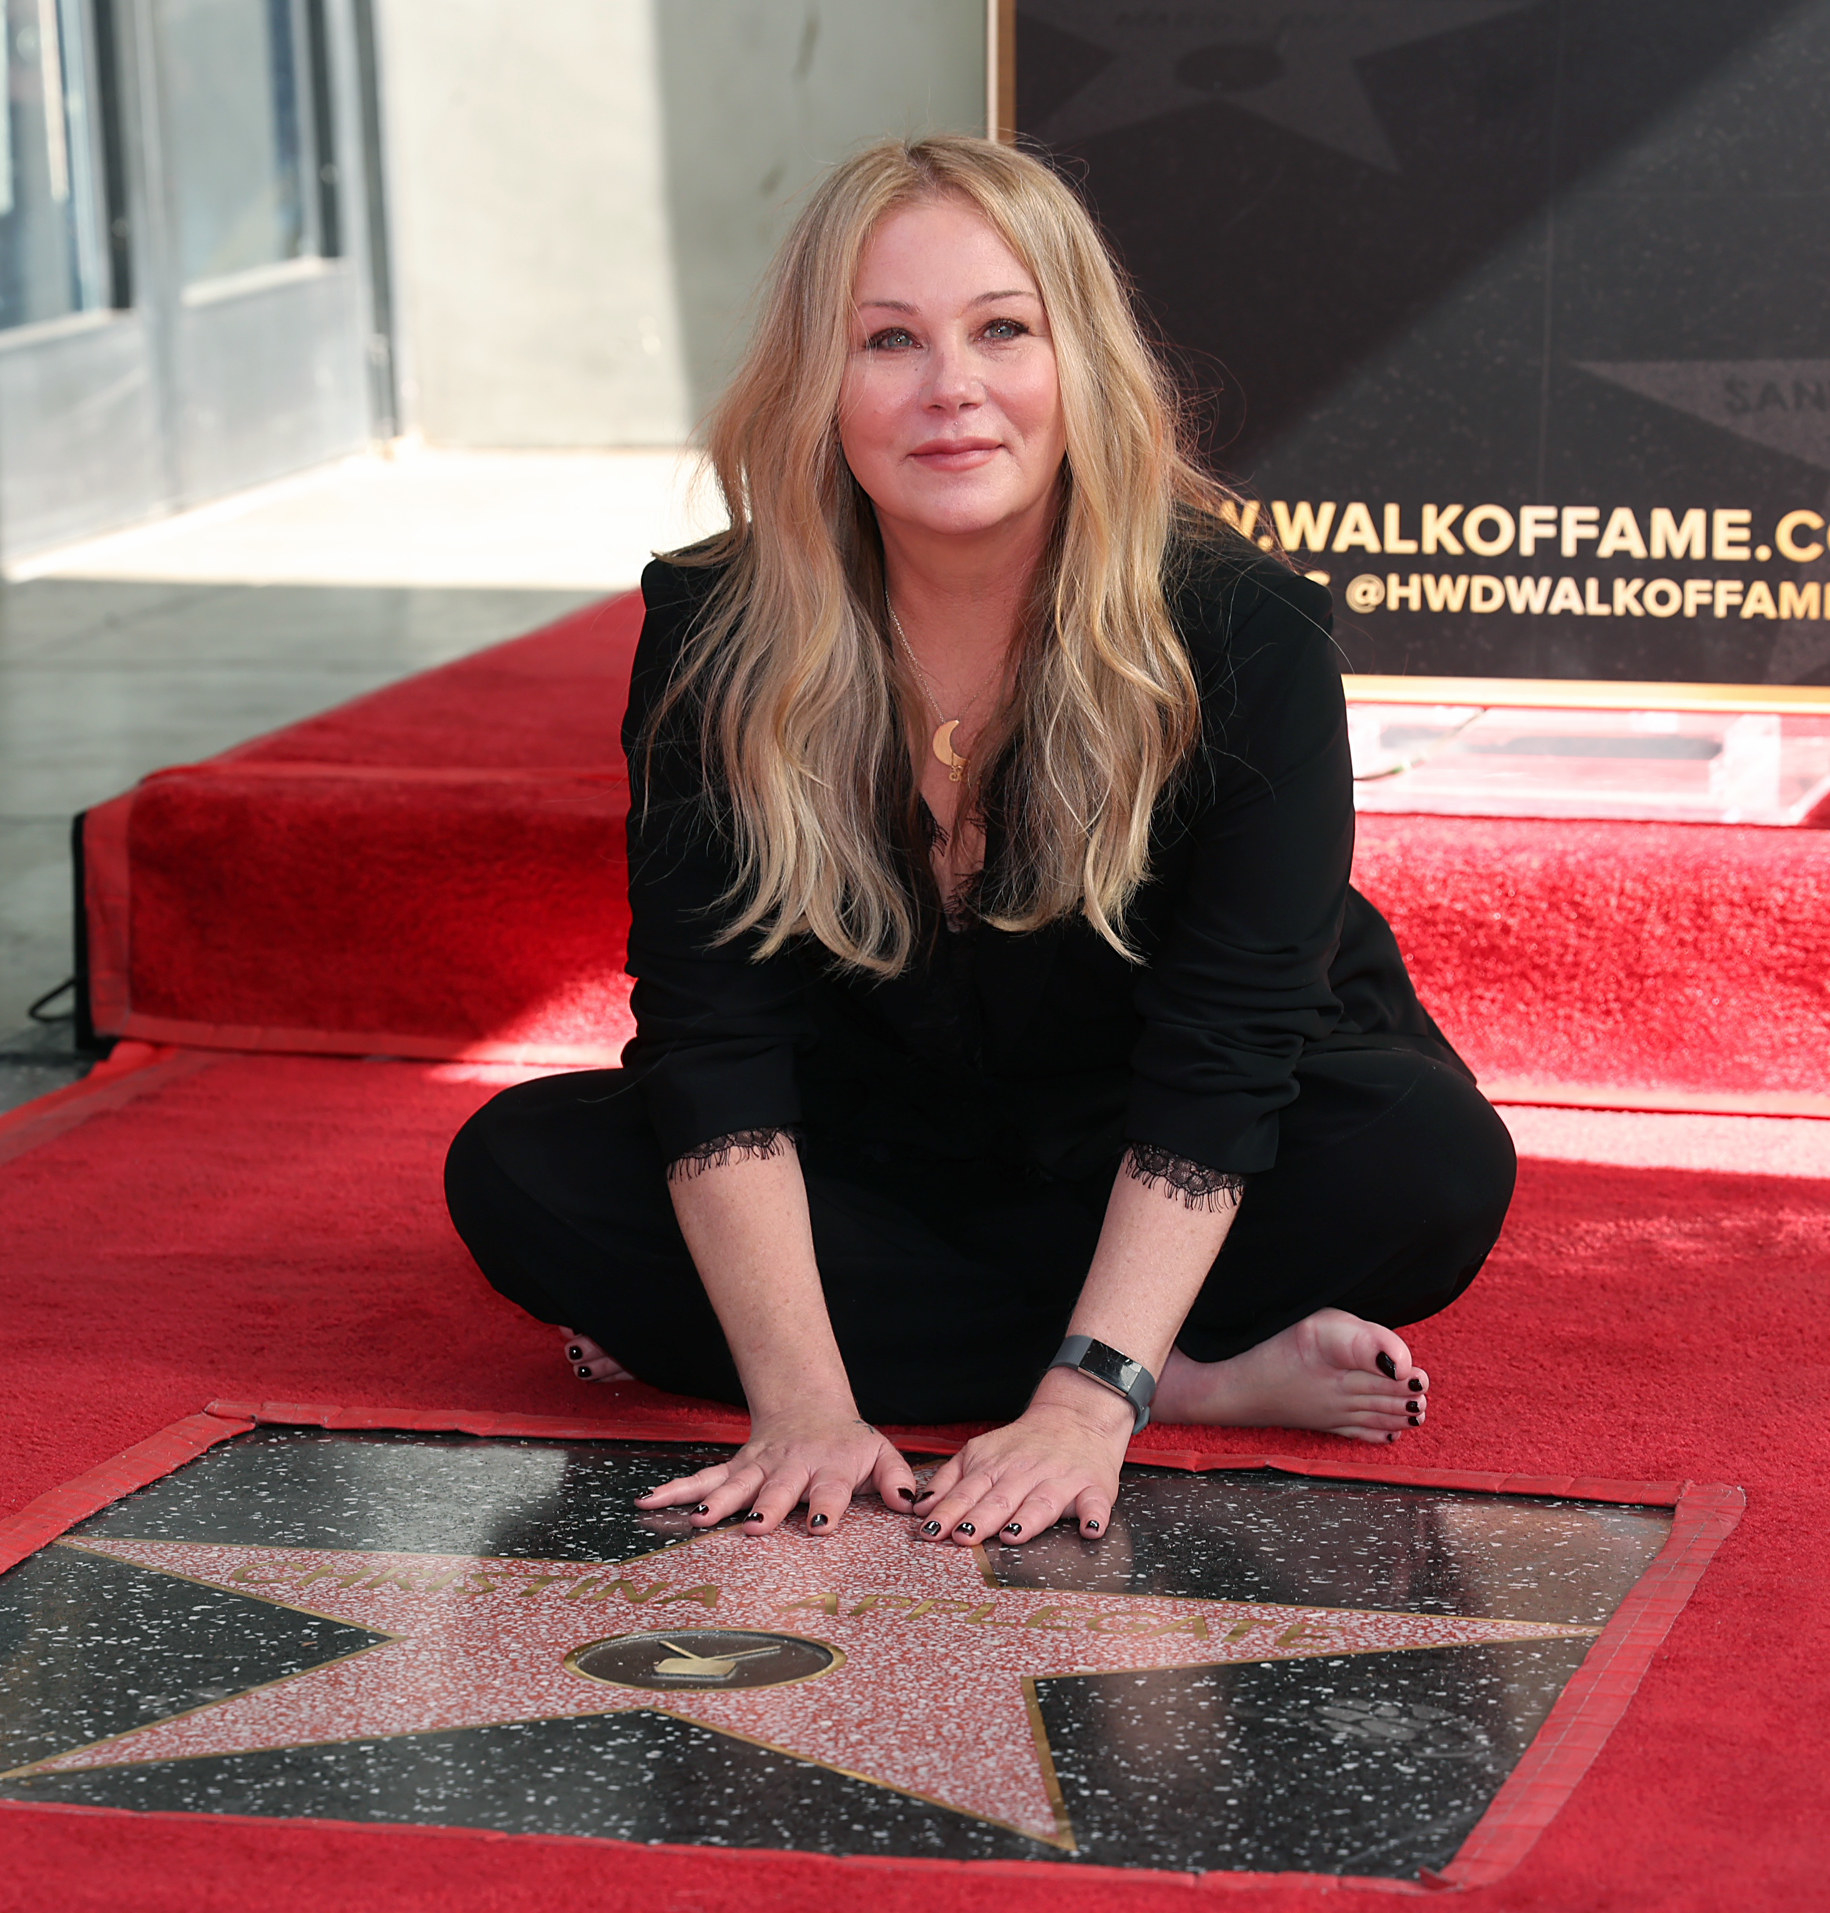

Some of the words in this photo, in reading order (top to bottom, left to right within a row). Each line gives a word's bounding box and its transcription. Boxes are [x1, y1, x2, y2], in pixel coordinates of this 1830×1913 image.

[1723, 374, 1830, 415] SAN
[1220, 499, 1830, 564] .WALKOFFAME.C
[1345, 572, 1830, 621] @HWDWALKOFFAM
[231, 1560, 720, 1608] CHRISTINA
[778, 1591, 1350, 1649] APPLEGATE
